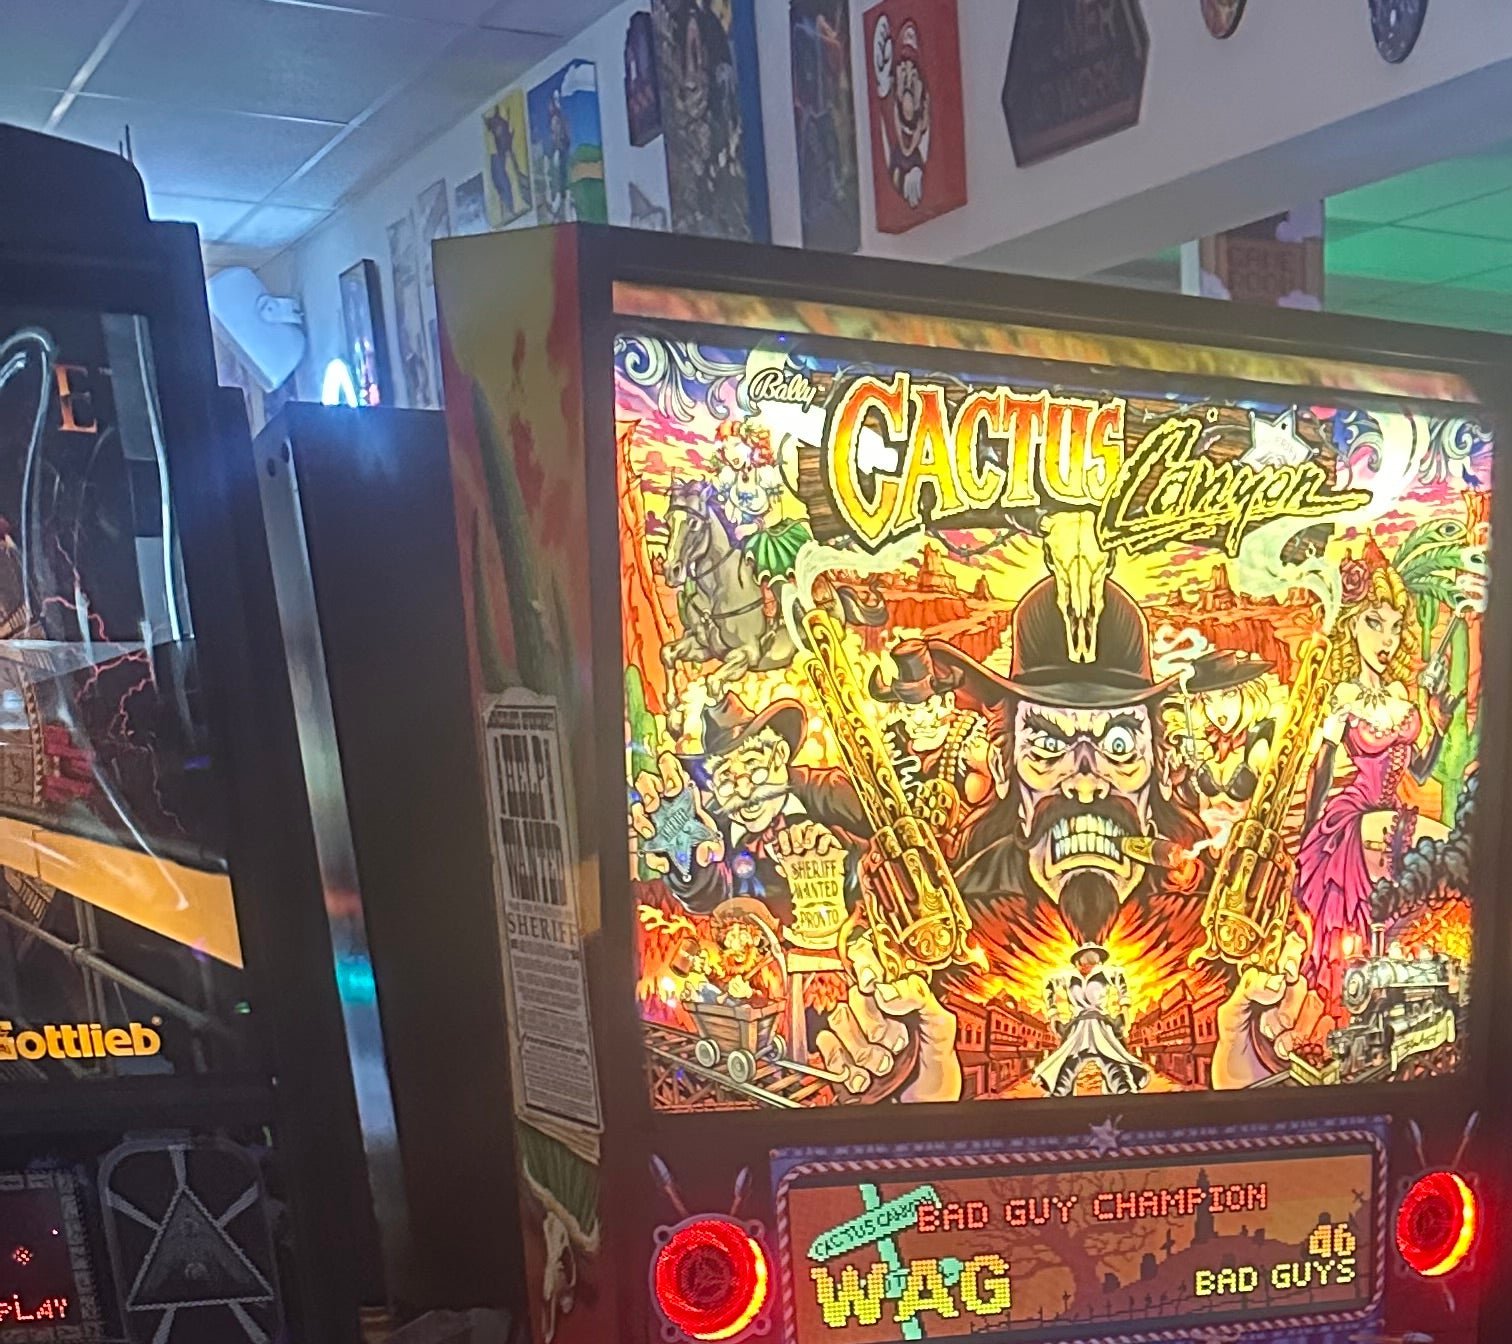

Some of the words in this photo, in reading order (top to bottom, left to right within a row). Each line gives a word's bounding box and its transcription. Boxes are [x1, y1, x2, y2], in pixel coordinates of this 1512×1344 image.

[749, 366, 818, 412] Bally
[828, 372, 1126, 547] CACTUS
[1096, 416, 1374, 557] Canyon
[791, 858, 838, 881] SHERIFF
[794, 880, 840, 901] WANTED
[506, 911, 578, 946] SHERIFF
[916, 1201, 989, 1233] BAD
[1004, 1194, 1079, 1227] GUY
[1093, 1183, 1267, 1221] CHAMPION
[814, 1219, 877, 1257] CACTUS
[810, 1254, 1012, 1328] WAG
[1195, 1265, 1258, 1296] BAD
[1271, 1257, 1357, 1290] GUYS
